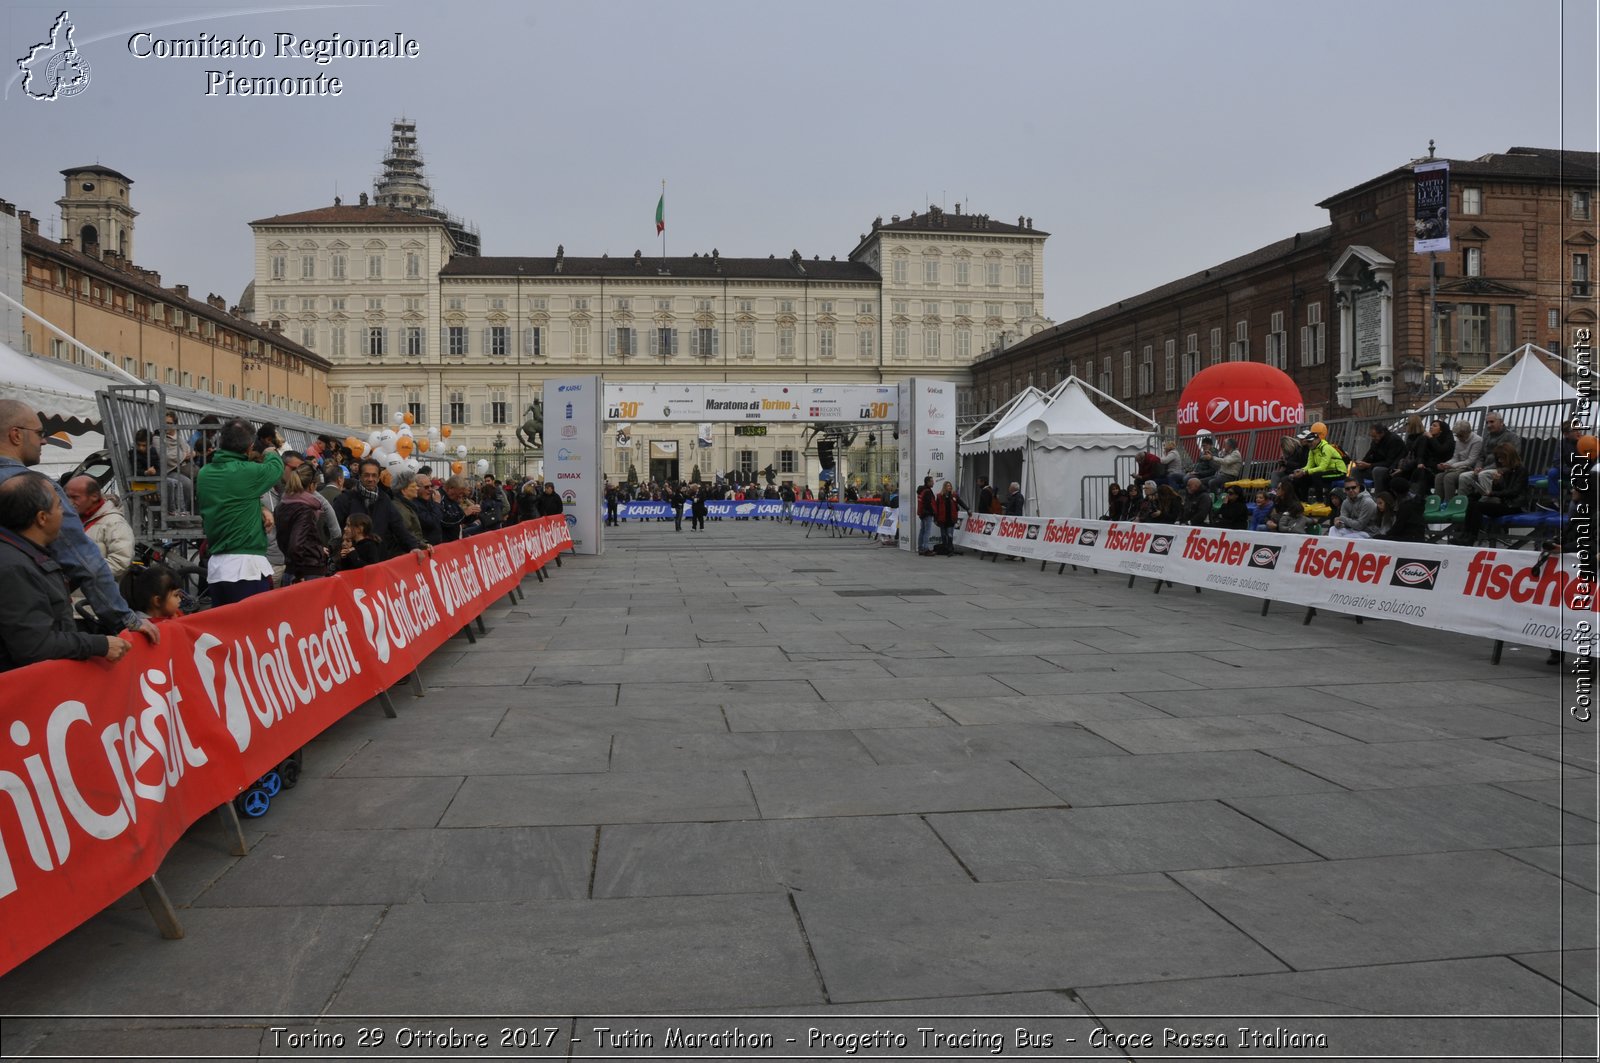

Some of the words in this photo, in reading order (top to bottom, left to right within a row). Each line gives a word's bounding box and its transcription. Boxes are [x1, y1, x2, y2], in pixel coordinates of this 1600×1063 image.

[705, 399, 748, 410] Maratona
[749, 400, 760, 410] di
[761, 398, 791, 410] Torino
[628, 505, 666, 515] KARHU
[997, 516, 1027, 539] fischer
[1043, 519, 1081, 544] fischer
[1104, 523, 1152, 553] fischer
[1182, 529, 1251, 566] fischer
[1294, 537, 1392, 584] fischer
[442, 553, 482, 609] UniCredit
[1206, 573, 1239, 587] innovative
[1238, 575, 1270, 592] solutions
[377, 572, 440, 649] UniCredit
[1328, 591, 1377, 610] innovative
[1377, 597, 1427, 618] solutions
[234, 604, 361, 729] UniCredit
